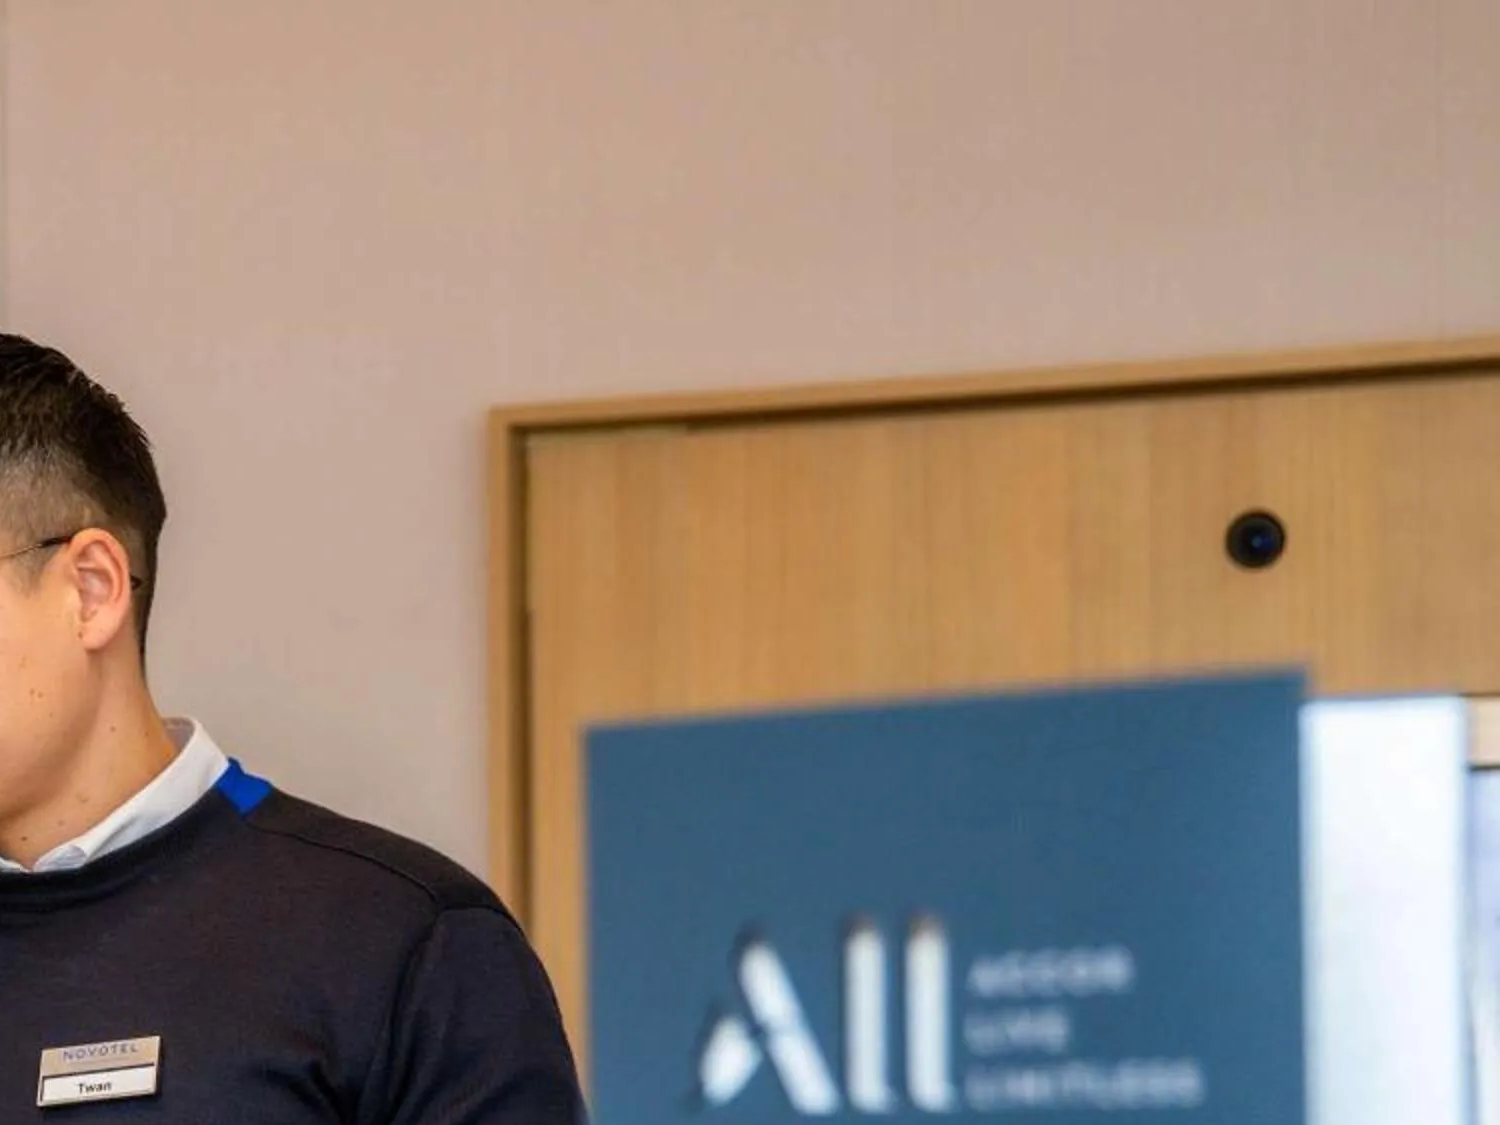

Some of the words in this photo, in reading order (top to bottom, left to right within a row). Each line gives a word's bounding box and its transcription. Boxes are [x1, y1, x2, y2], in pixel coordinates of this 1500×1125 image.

[965, 944, 1137, 998] ACCOR
[63, 1043, 139, 1060] NOVOTEL
[964, 1005, 1072, 1056] LIVE
[77, 1082, 113, 1094] Twan
[964, 1056, 1206, 1110] LIMITLESS
